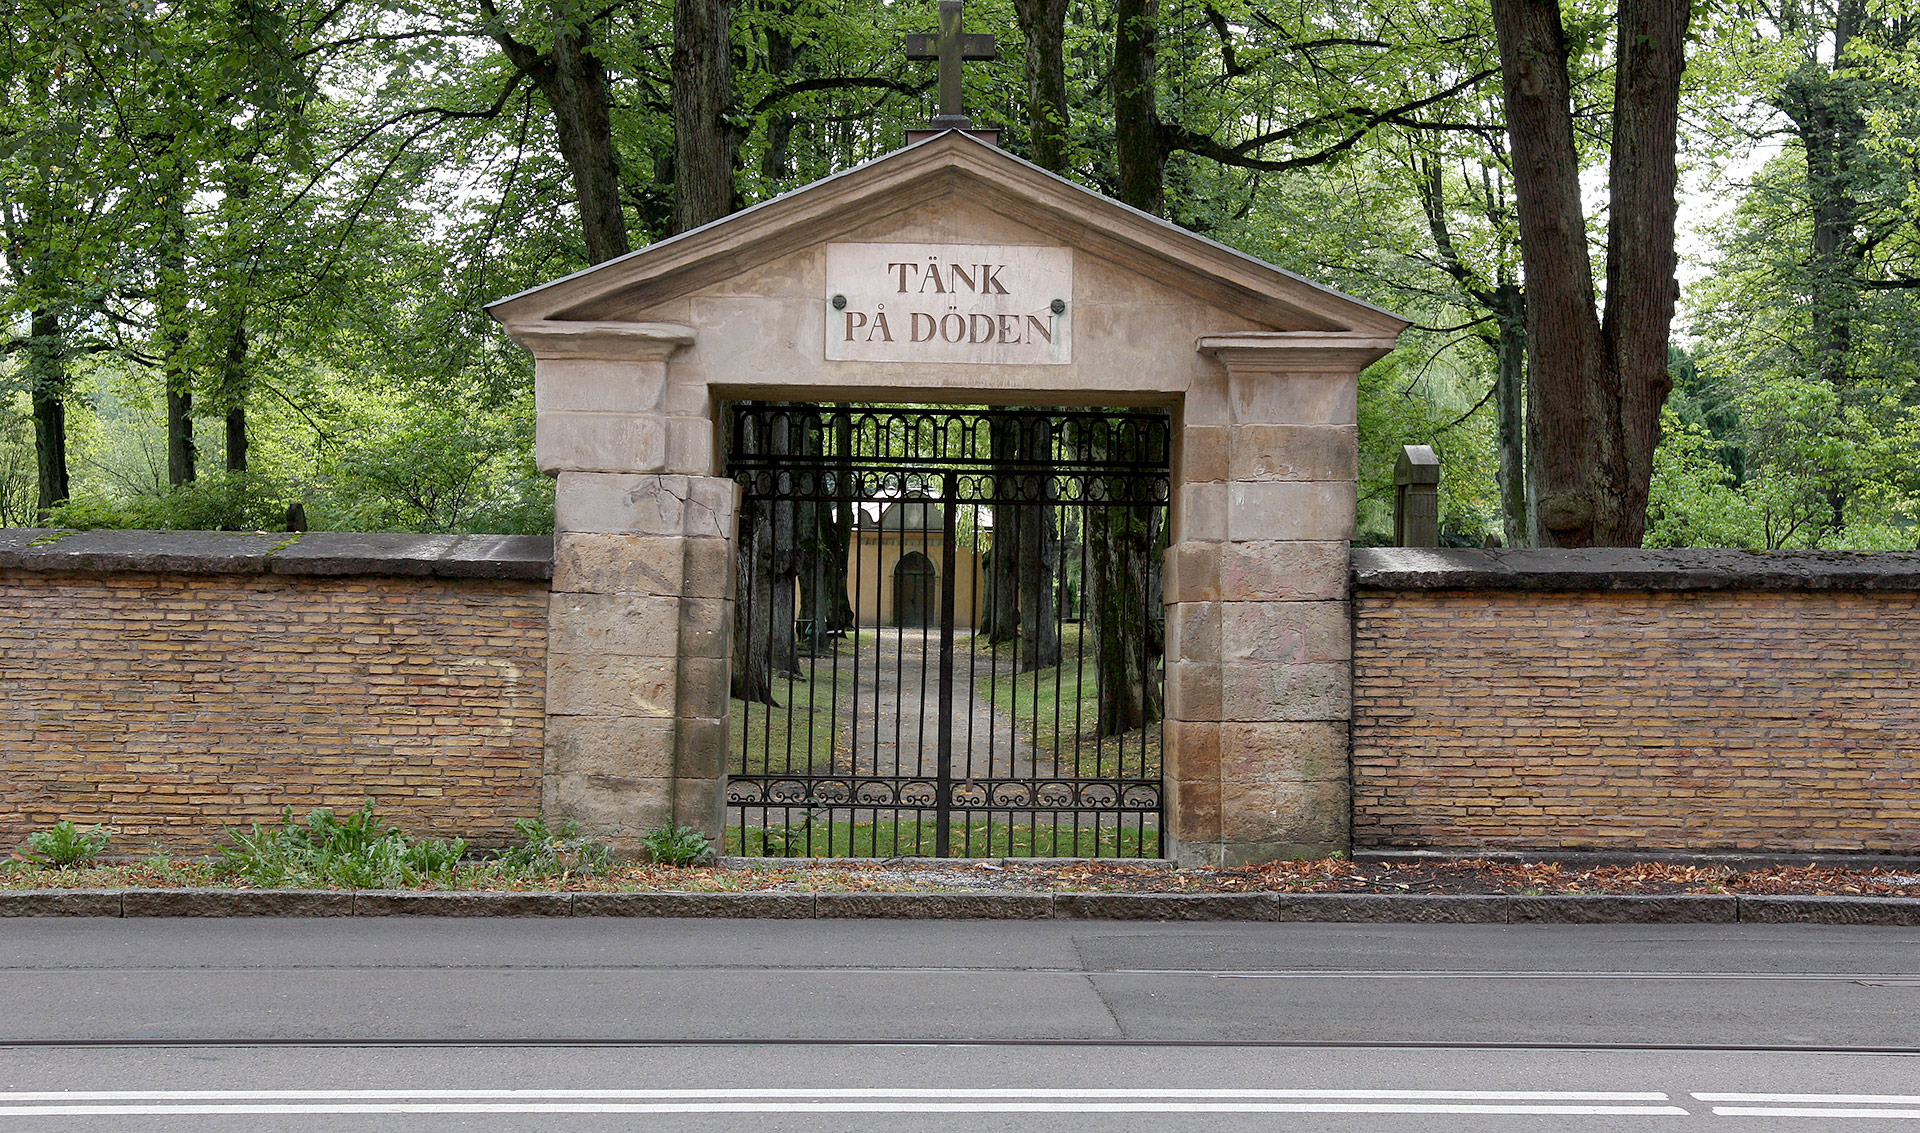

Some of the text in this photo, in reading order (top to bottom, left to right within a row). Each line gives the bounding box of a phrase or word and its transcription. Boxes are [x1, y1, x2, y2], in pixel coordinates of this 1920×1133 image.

[887, 256, 1010, 295] TÄNK
[843, 303, 1054, 345] PÅ DÖDEN
